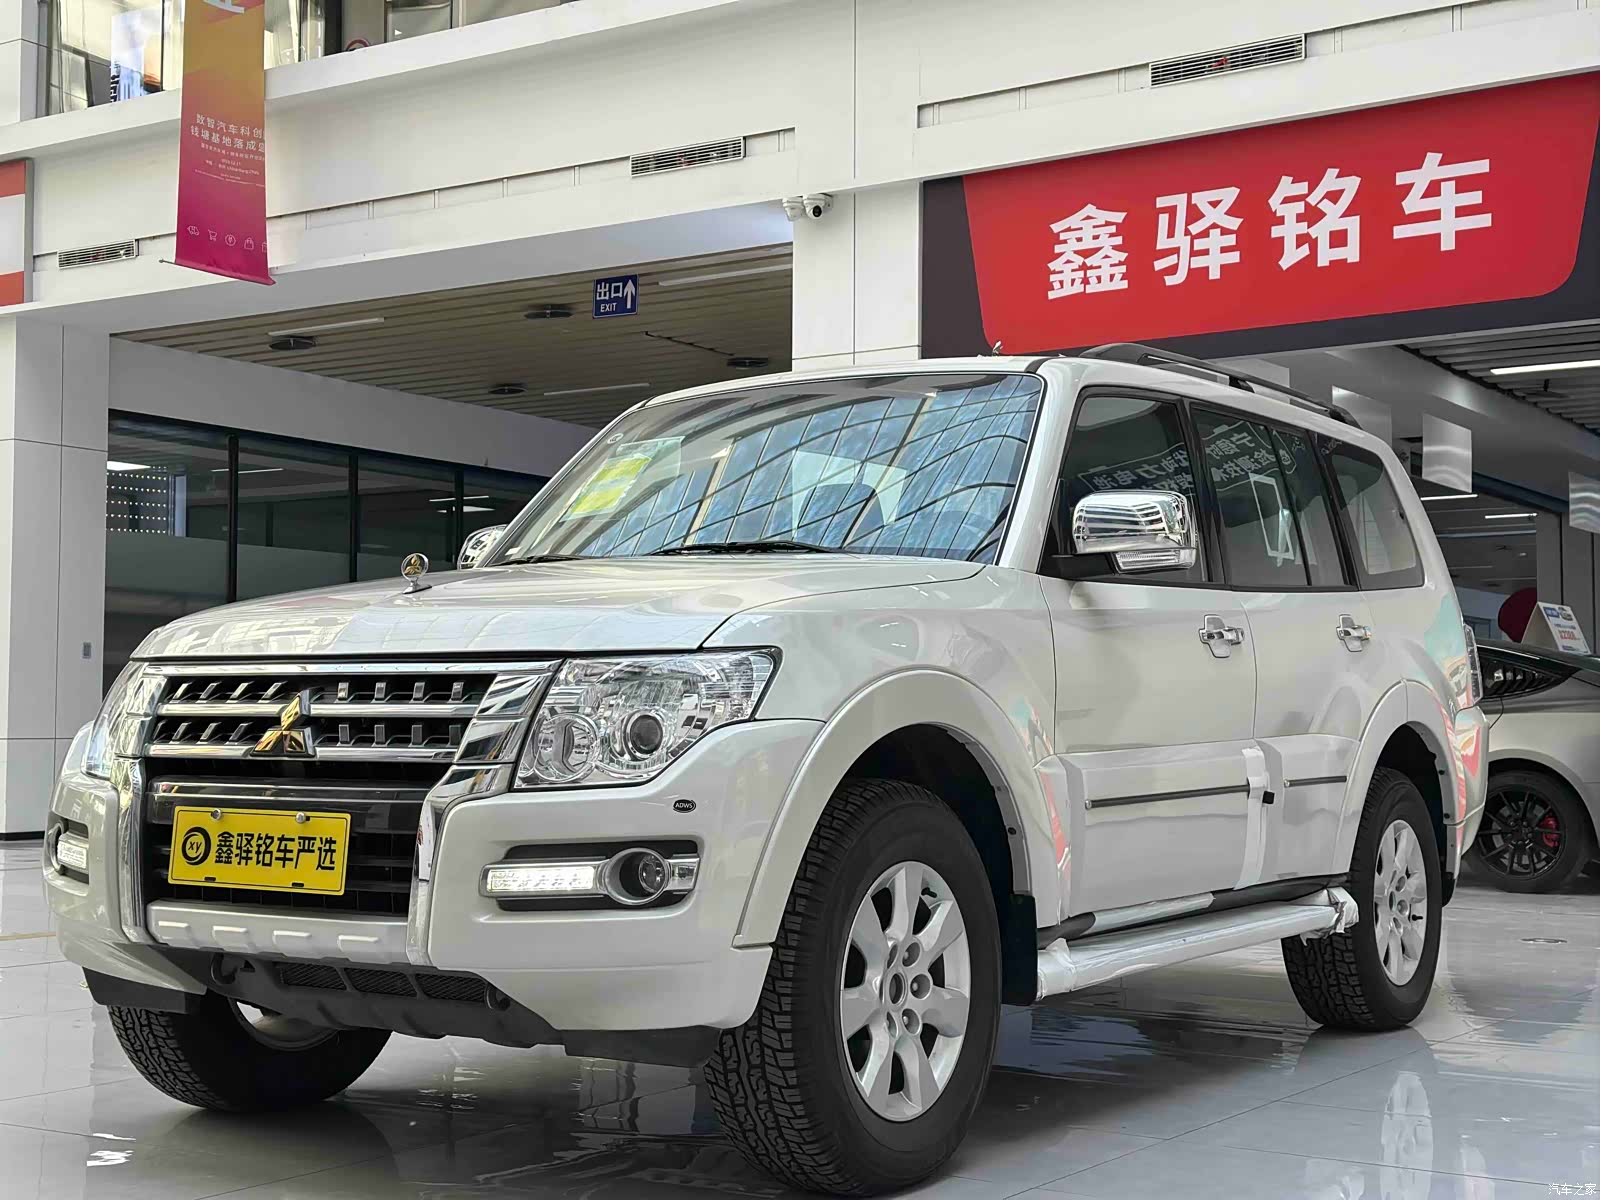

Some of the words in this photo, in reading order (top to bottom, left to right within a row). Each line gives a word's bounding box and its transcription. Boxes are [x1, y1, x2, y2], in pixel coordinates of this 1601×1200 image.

[196, 113, 264, 139] 数智汽车科创
[1047, 152, 1492, 300] 鑫驿铭车
[596, 281, 623, 300] 出口
[600, 302, 617, 312] EXIT
[214, 831, 337, 871] 鑫驿铭车严选
